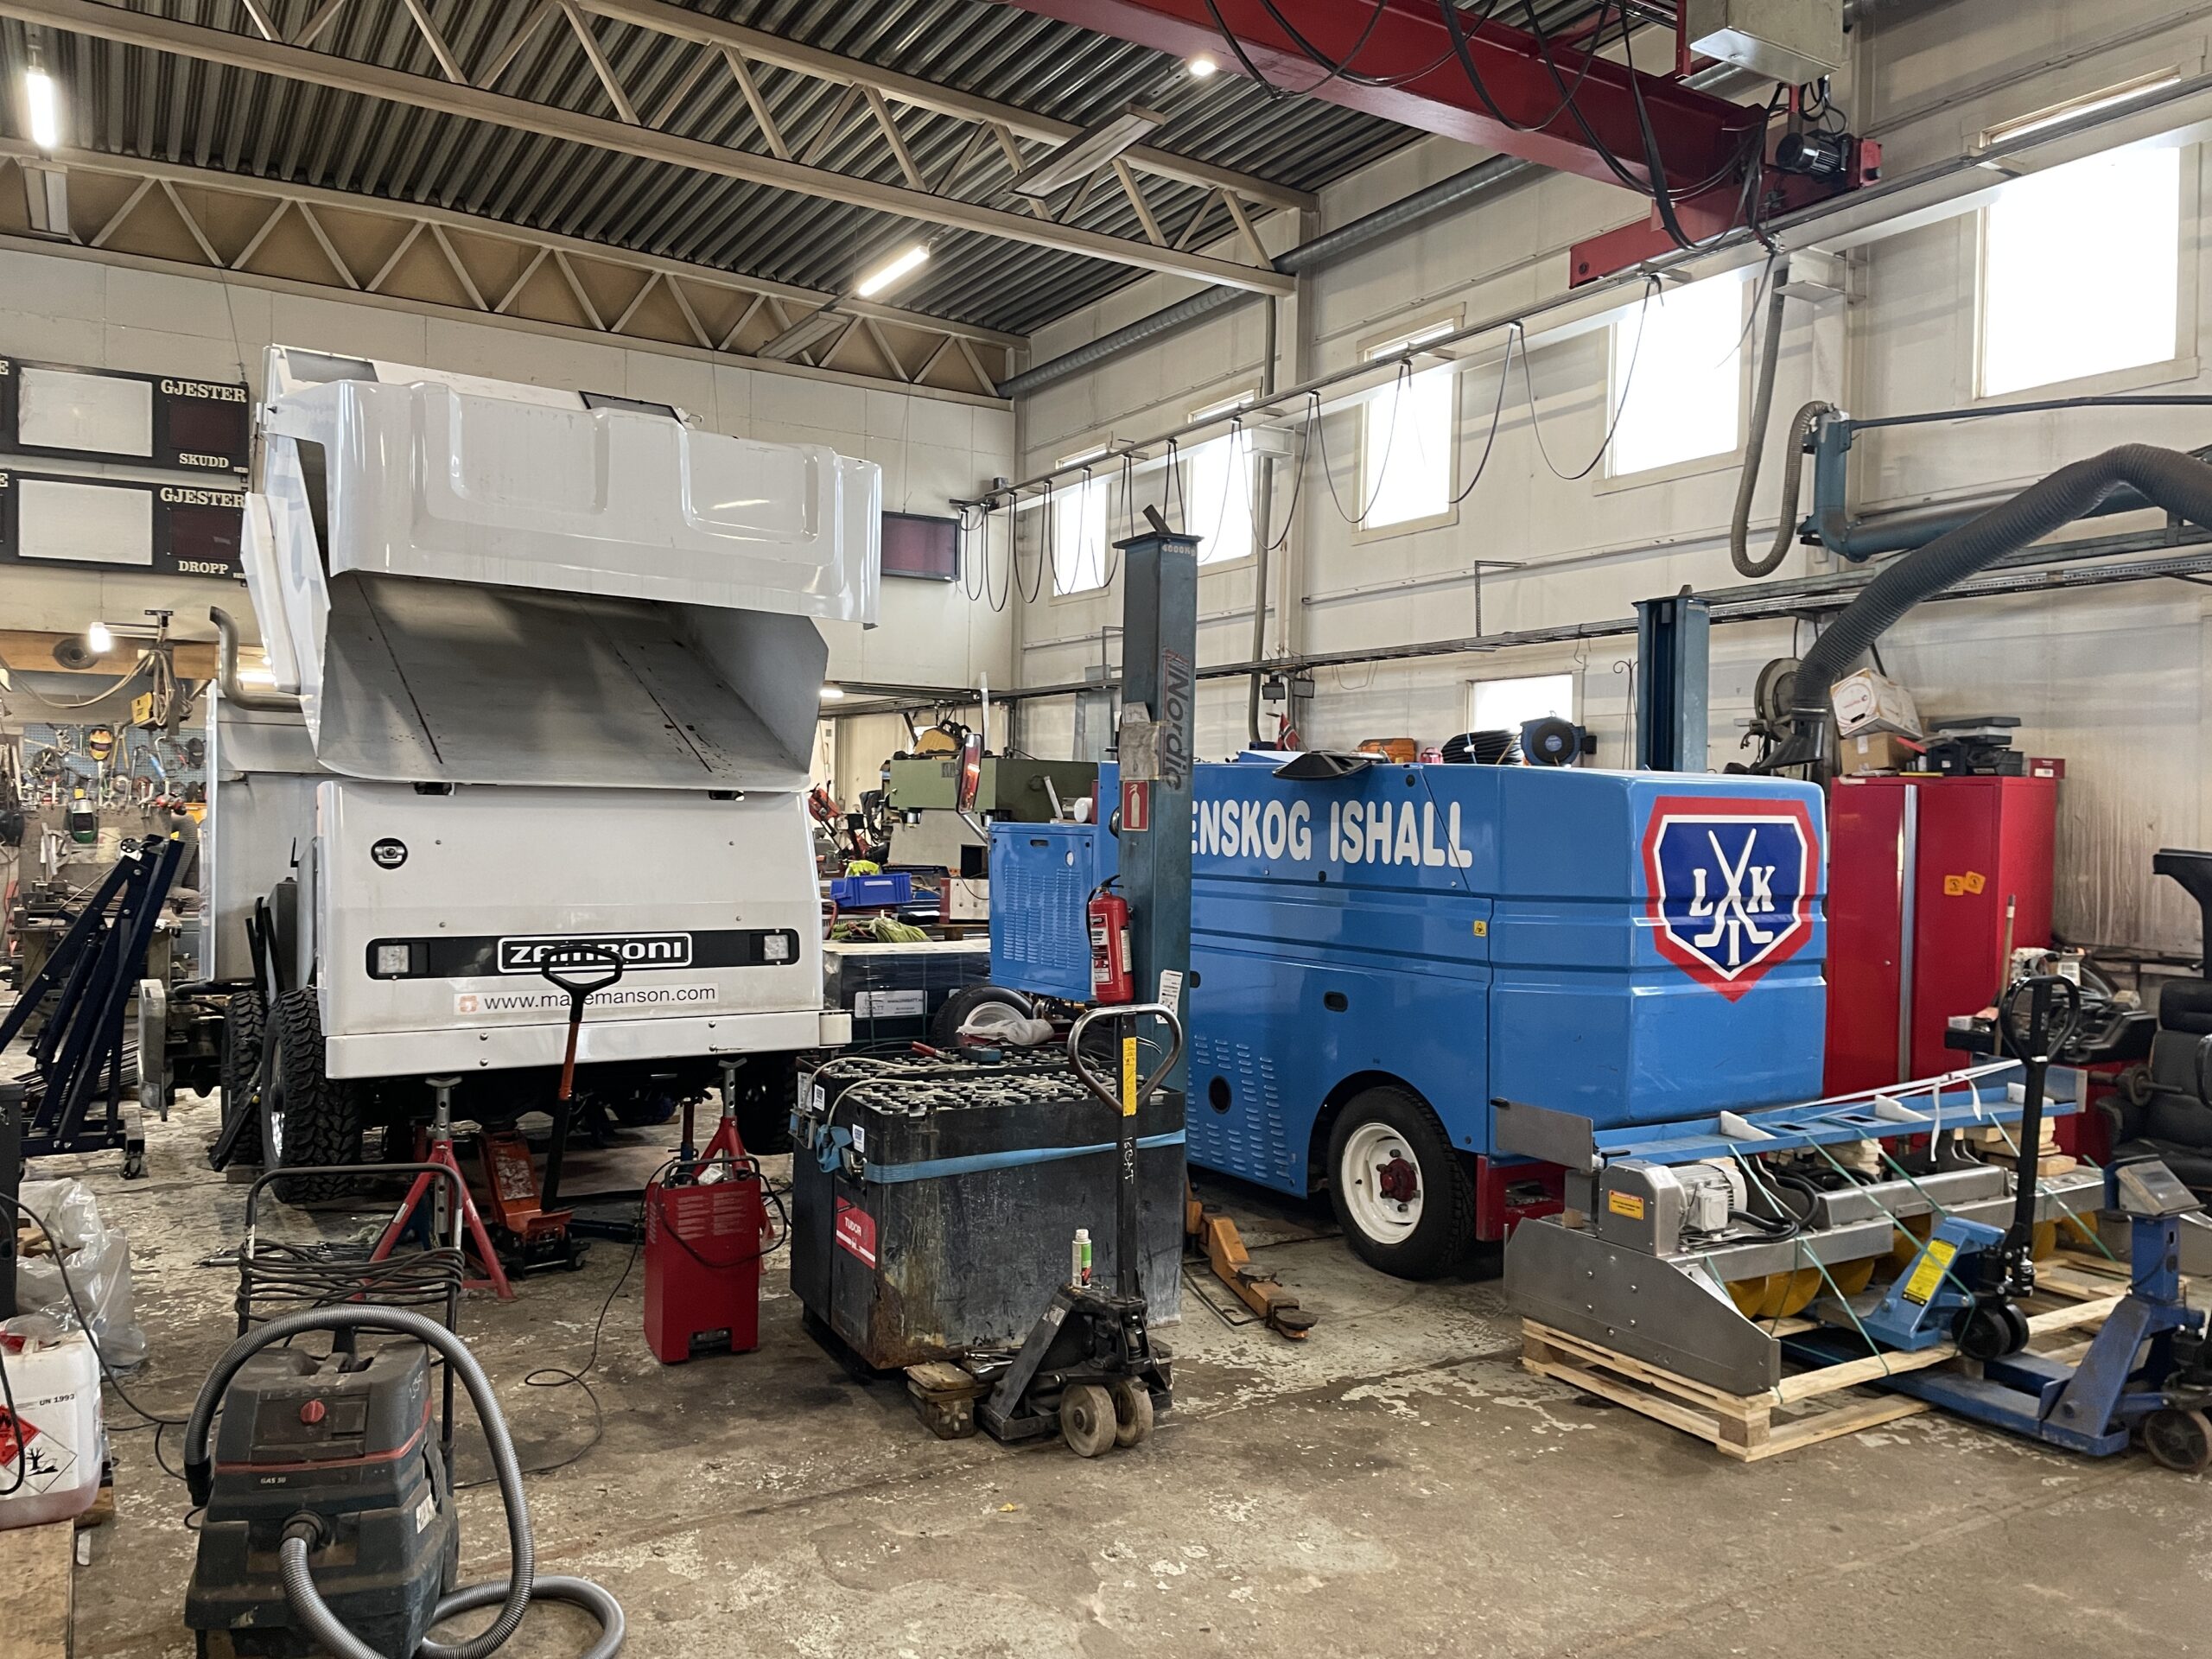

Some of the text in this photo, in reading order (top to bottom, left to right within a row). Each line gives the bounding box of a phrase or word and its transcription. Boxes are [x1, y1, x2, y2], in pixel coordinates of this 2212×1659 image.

[161, 379, 247, 403] GJESTER
[179, 453, 229, 468] SKUDD
[160, 487, 245, 508] GJESTER
[178, 560, 229, 575] DROPP
[1330, 800, 1472, 868] ISHALL
[484, 988, 715, 1009] www.maemanson.com
[844, 1217, 862, 1236] TUDOR
[54, 1393, 75, 1404] 1993
